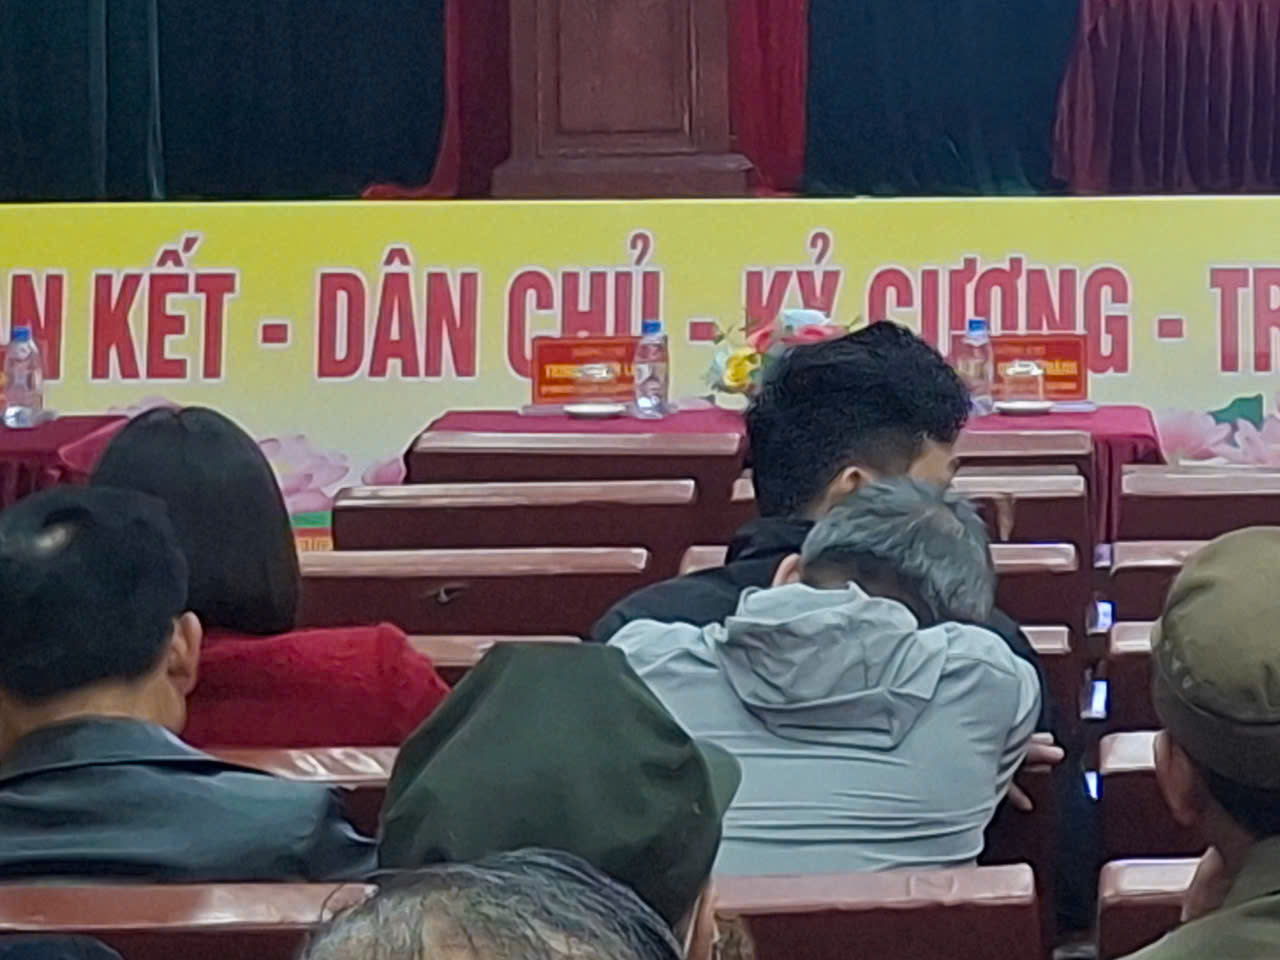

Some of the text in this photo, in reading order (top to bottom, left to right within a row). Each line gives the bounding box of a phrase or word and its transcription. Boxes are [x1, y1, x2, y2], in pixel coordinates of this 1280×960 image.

[91, 236, 236, 379] KẾT
[316, 247, 479, 377] DÂN
[508, 232, 662, 377] CHỦ
[868, 256, 1130, 373] CƯƠNG
